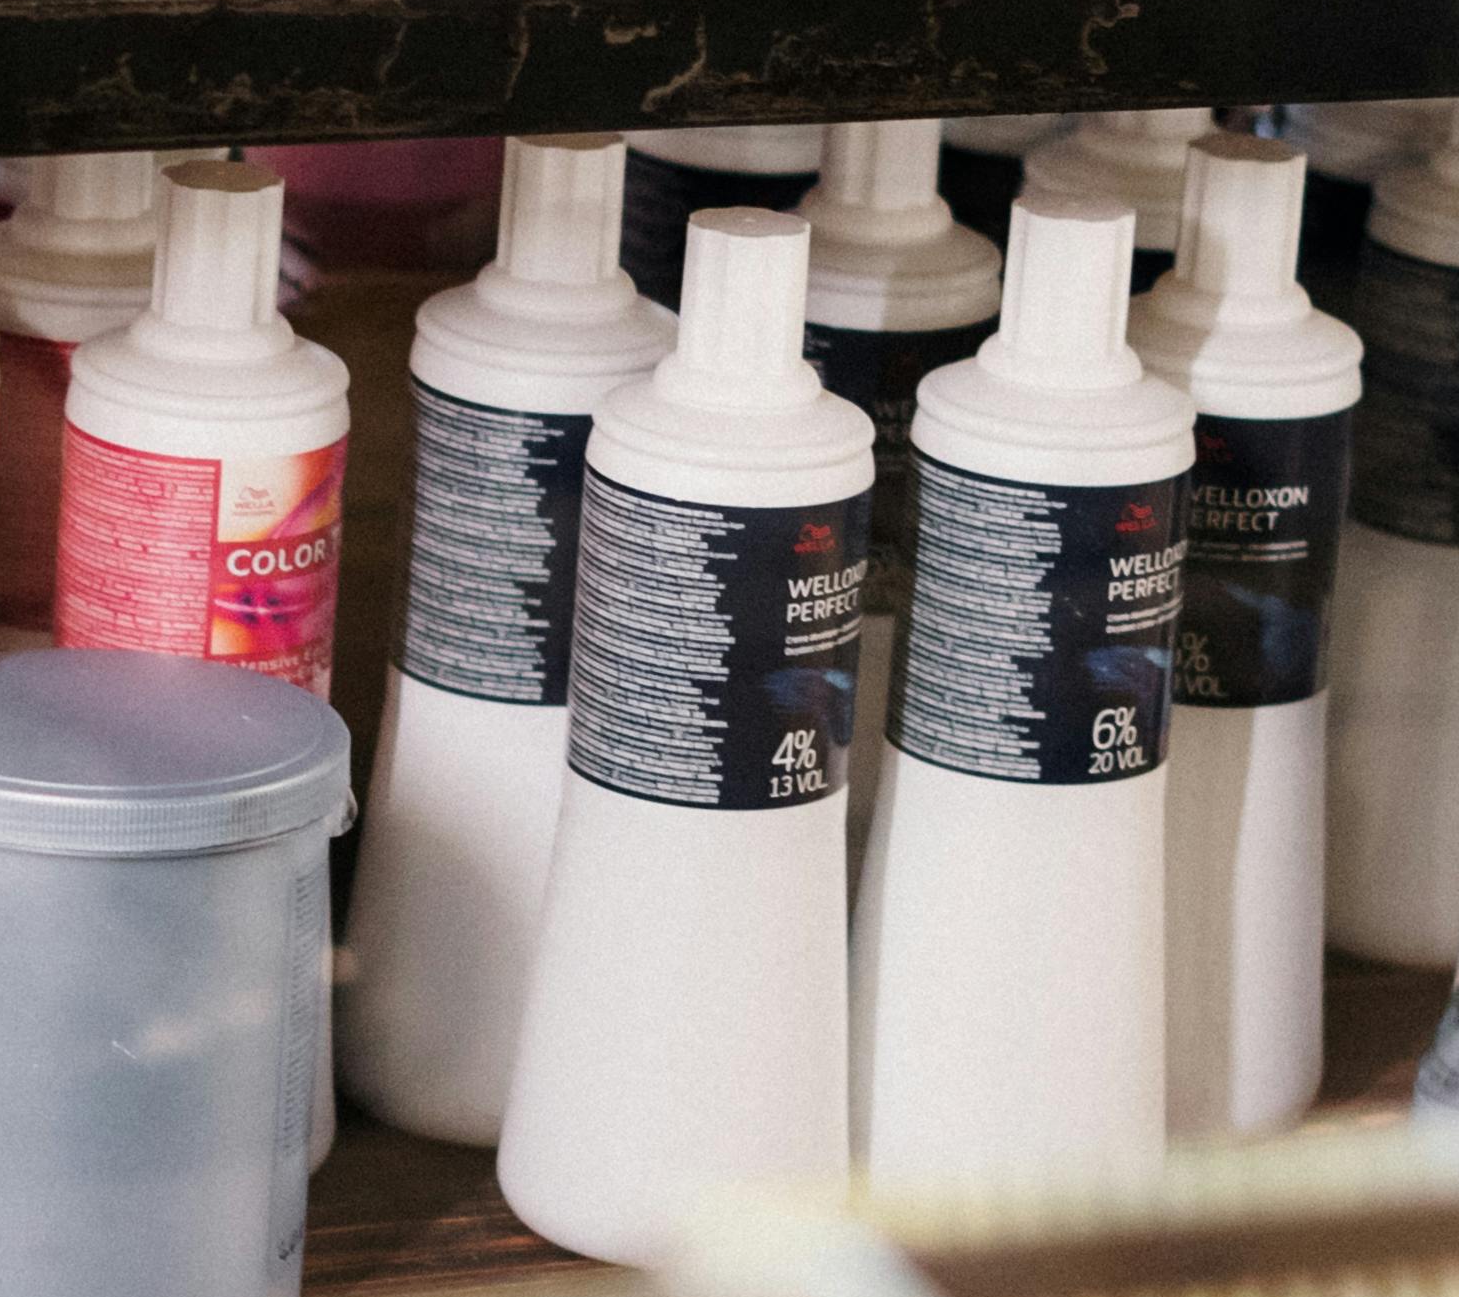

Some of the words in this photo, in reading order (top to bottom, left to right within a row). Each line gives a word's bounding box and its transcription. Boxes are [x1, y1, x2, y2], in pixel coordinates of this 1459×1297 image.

[1193, 510, 1280, 532] ERFECT
[226, 538, 327, 578] COLOR
[786, 587, 860, 623] PERFECT
[1092, 707, 1137, 751] 6%
[771, 729, 817, 773] 4%
[1088, 752, 1114, 775] 20
[1116, 747, 1149, 771] VOL
[769, 777, 793, 799] 13
[796, 769, 829, 794] VOL
